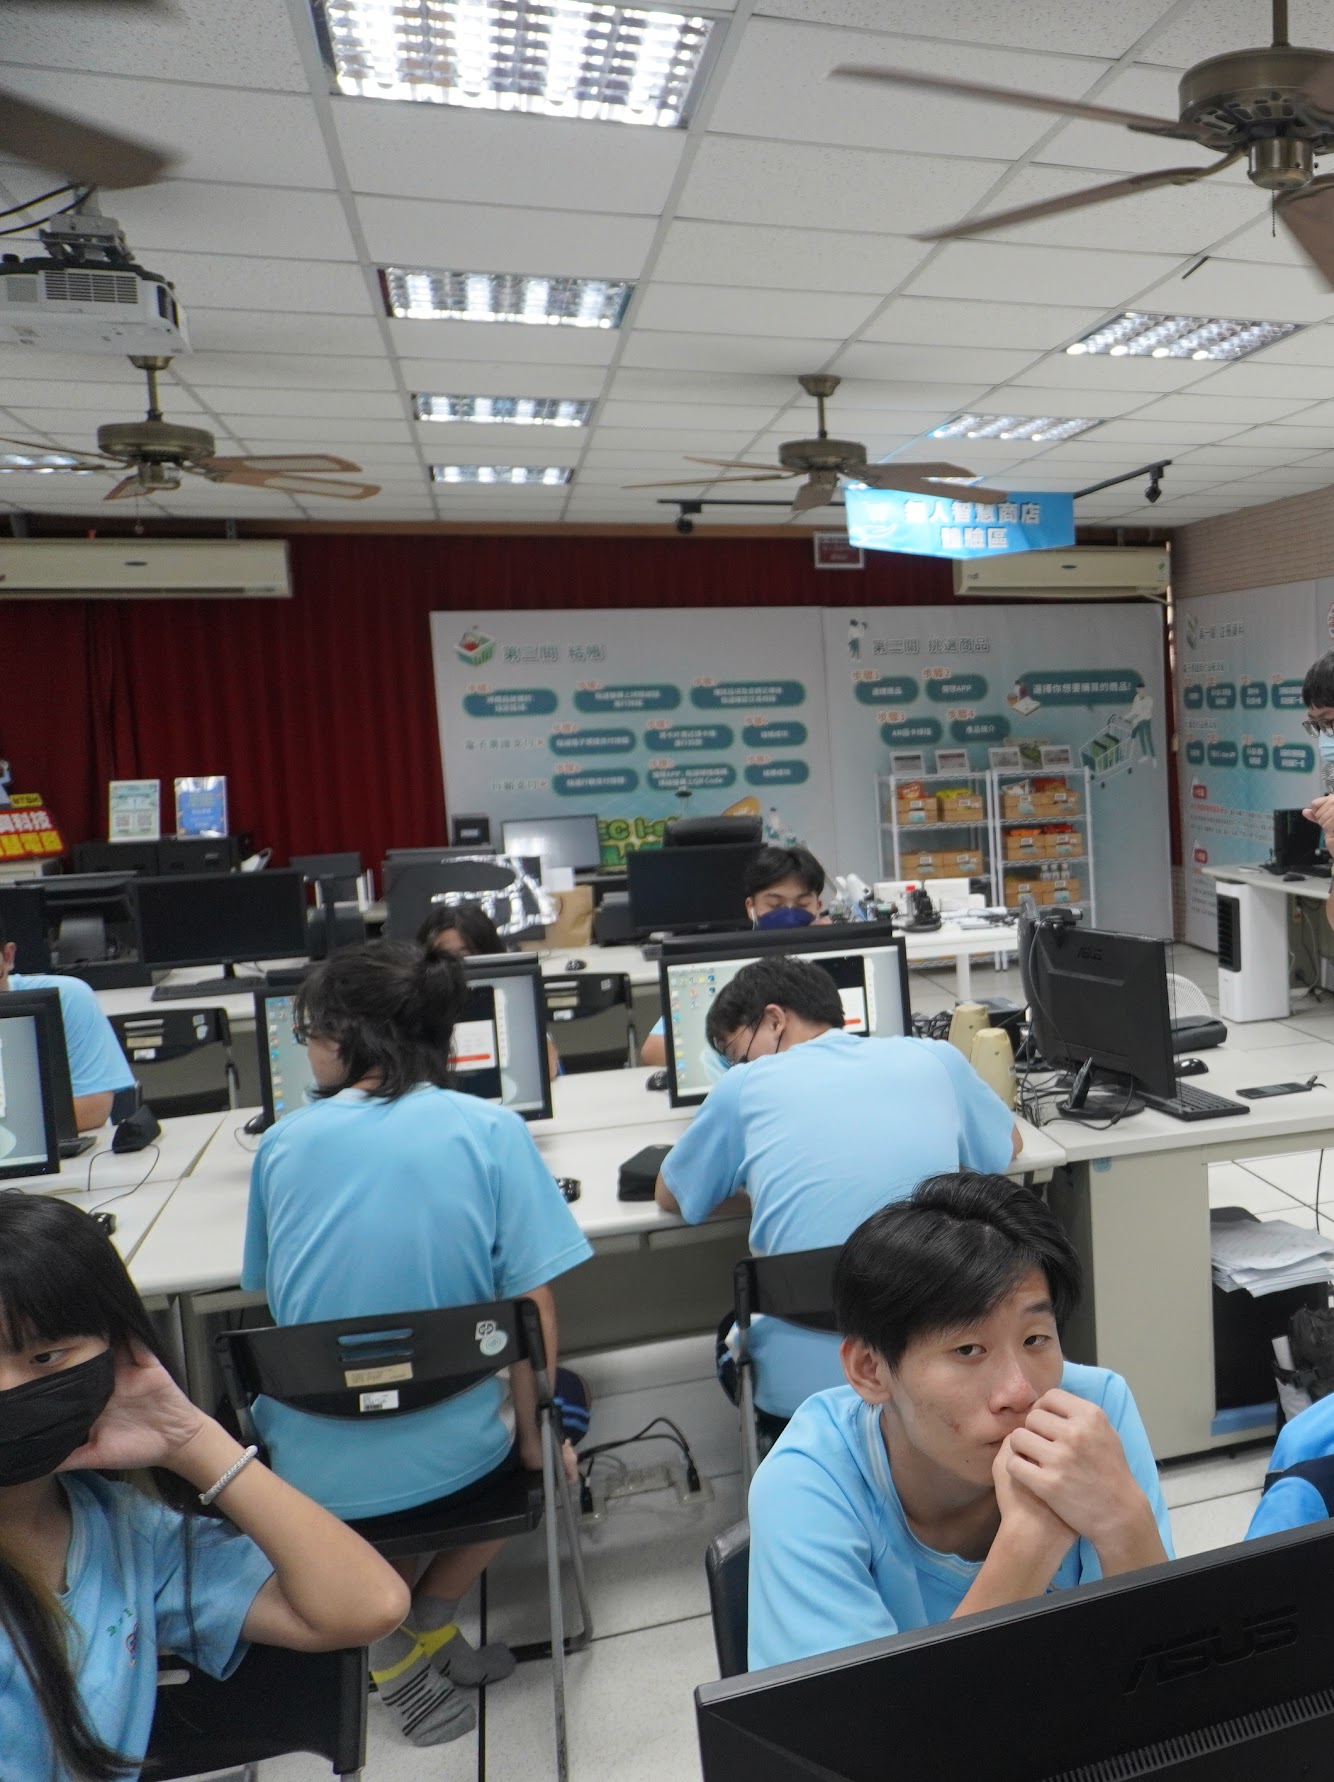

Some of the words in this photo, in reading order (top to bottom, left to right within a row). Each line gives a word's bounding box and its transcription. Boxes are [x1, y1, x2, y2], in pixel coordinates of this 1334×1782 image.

[904, 500, 1040, 524] 無人智慧商店
[1120, 1603, 1302, 1697] ASUS
